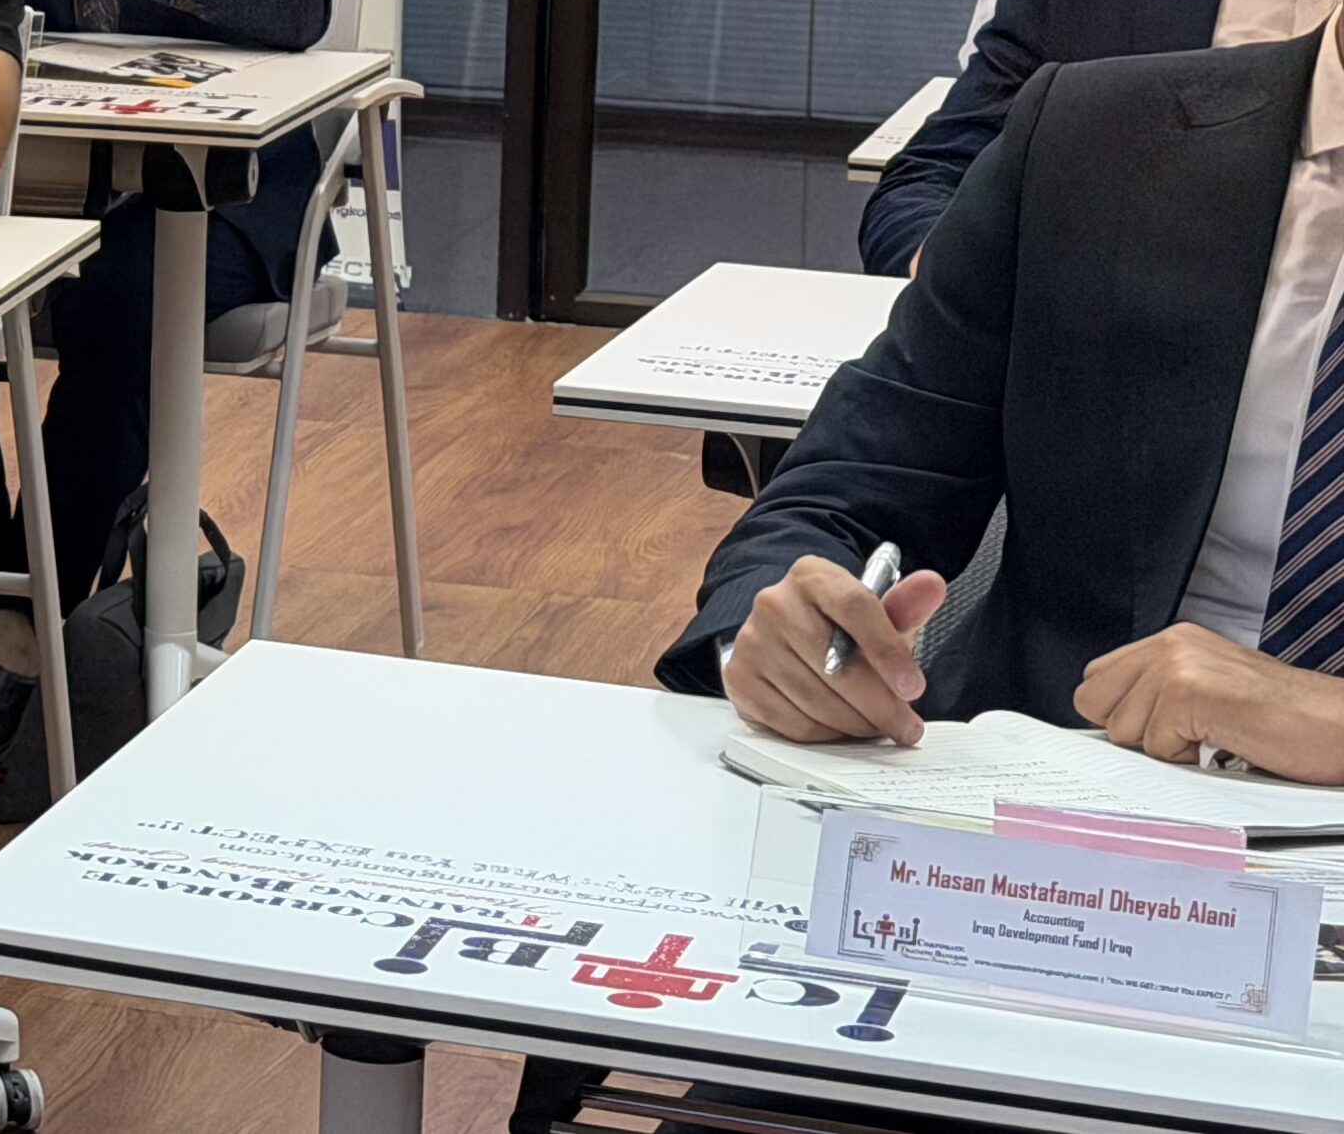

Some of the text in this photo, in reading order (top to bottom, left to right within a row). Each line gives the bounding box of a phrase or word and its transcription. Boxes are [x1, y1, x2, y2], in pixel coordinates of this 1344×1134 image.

[65, 850, 552, 929] TRAINING BANGKOK
[81, 870, 415, 928] CORPORATE
[890, 860, 1237, 928] Mr. Hasan Mustafamal Dheyab Alani
[972, 920, 995, 937] Iraq
[998, 923, 1069, 946] Development
[1073, 934, 1099, 950] Fund
[1109, 939, 1132, 957] Iraq
[1023, 909, 1085, 931] Accounting
